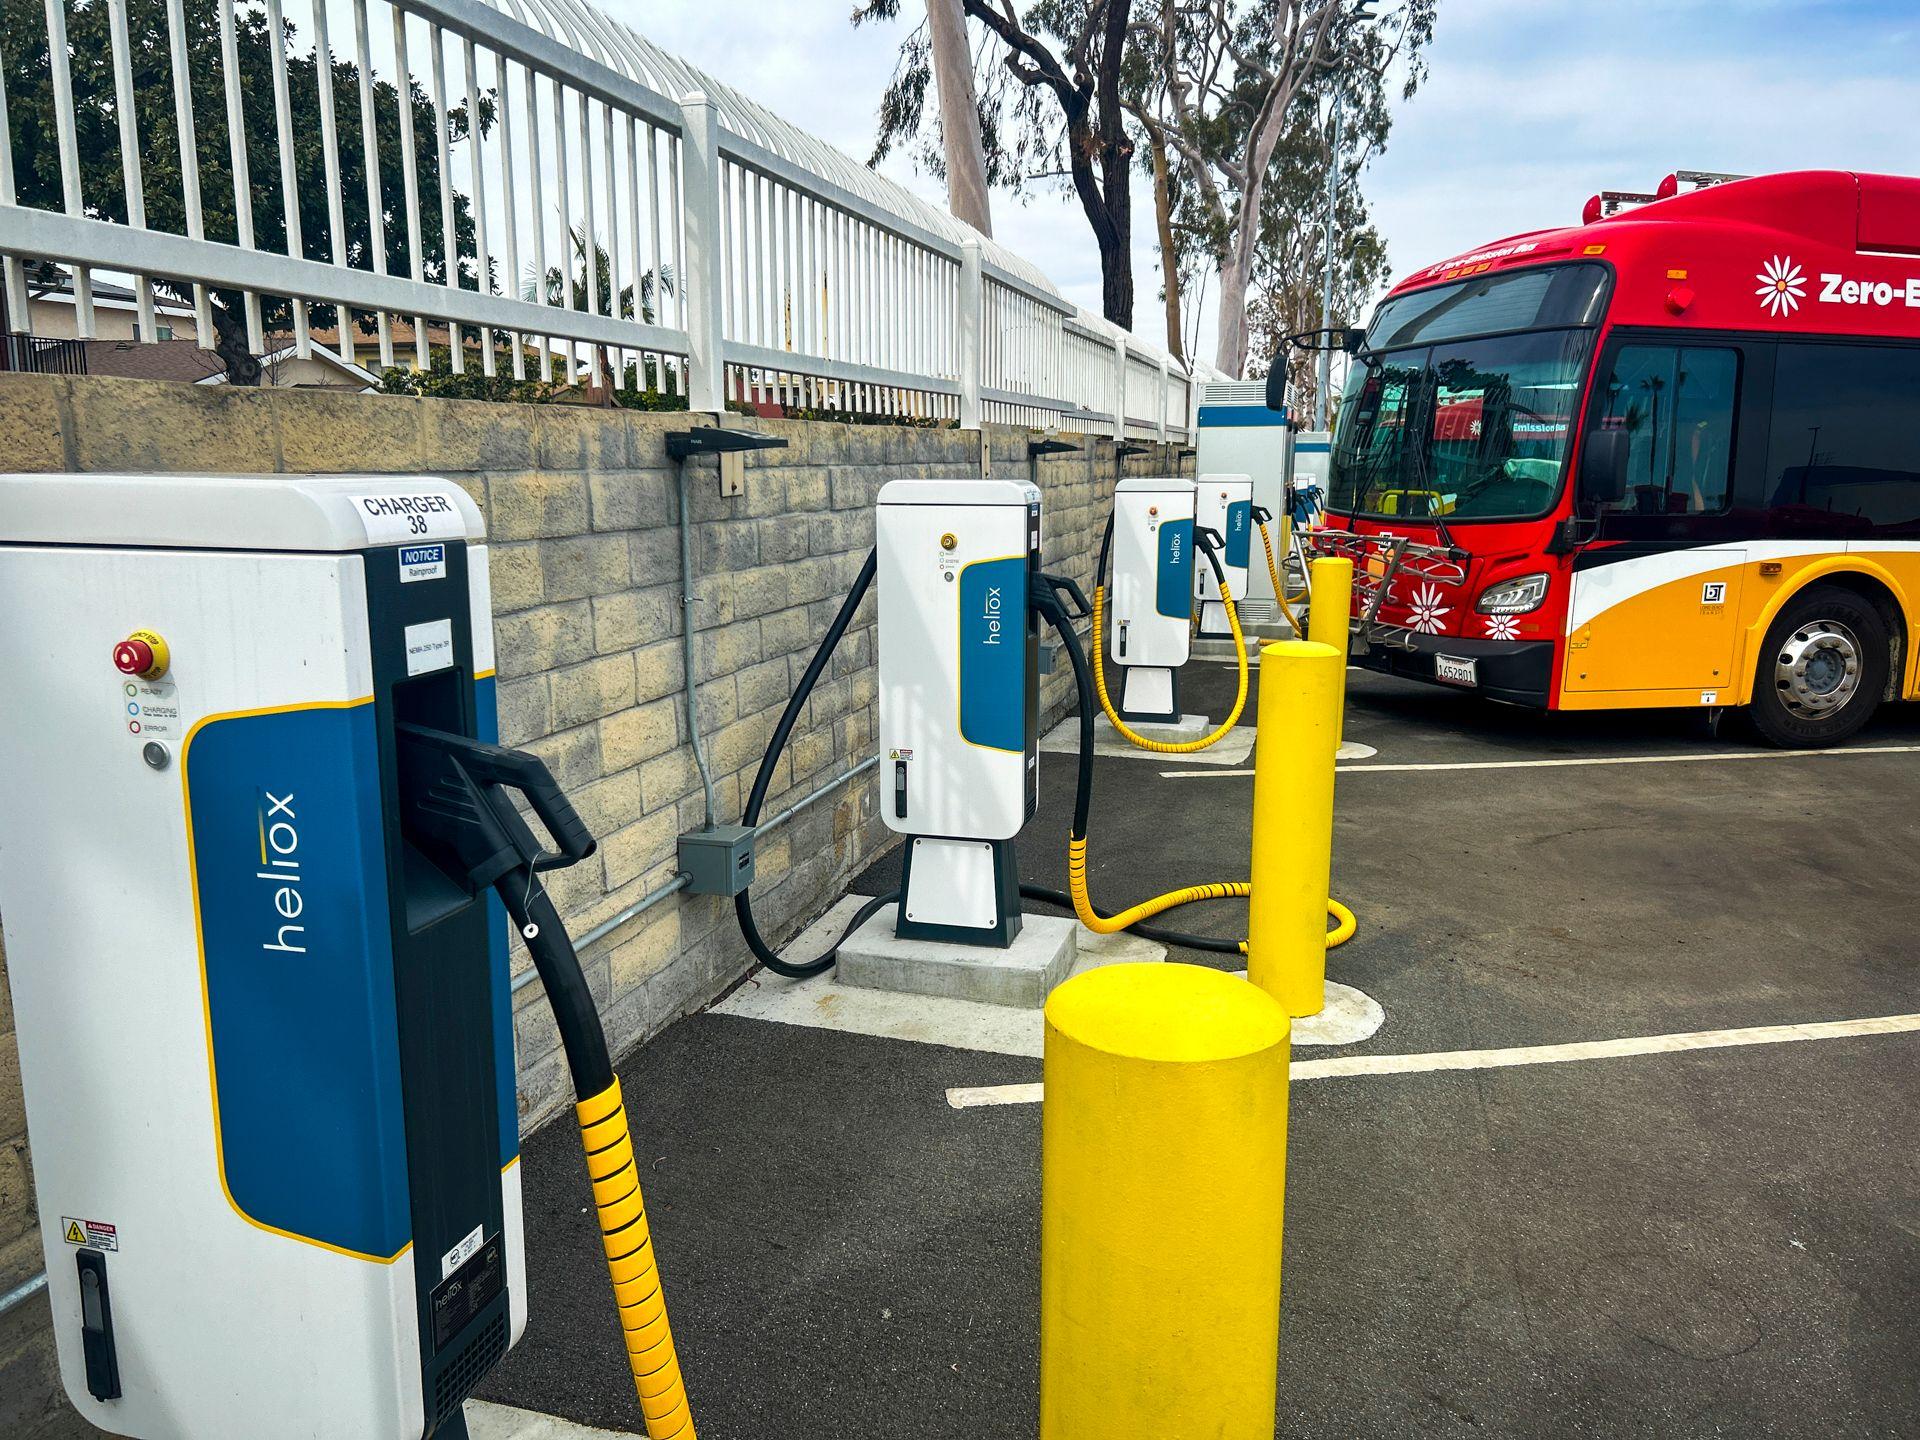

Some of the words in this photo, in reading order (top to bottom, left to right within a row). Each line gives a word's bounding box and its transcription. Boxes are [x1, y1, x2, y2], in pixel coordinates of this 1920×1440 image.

[1819, 273, 1920, 307] Zero-E
[363, 495, 452, 516] CHARGER
[407, 514, 428, 535] 38
[405, 549, 439, 563] NOTICE
[1170, 533, 1181, 564] heliox
[409, 565, 438, 577] Rainproof
[983, 587, 1001, 644] heliox
[1439, 664, 1473, 683] 1652801
[142, 706, 177, 715] CHARGING
[257, 791, 306, 953] heliox
[92, 1223, 114, 1232] DANGER
[435, 1280, 463, 1312] heliox
